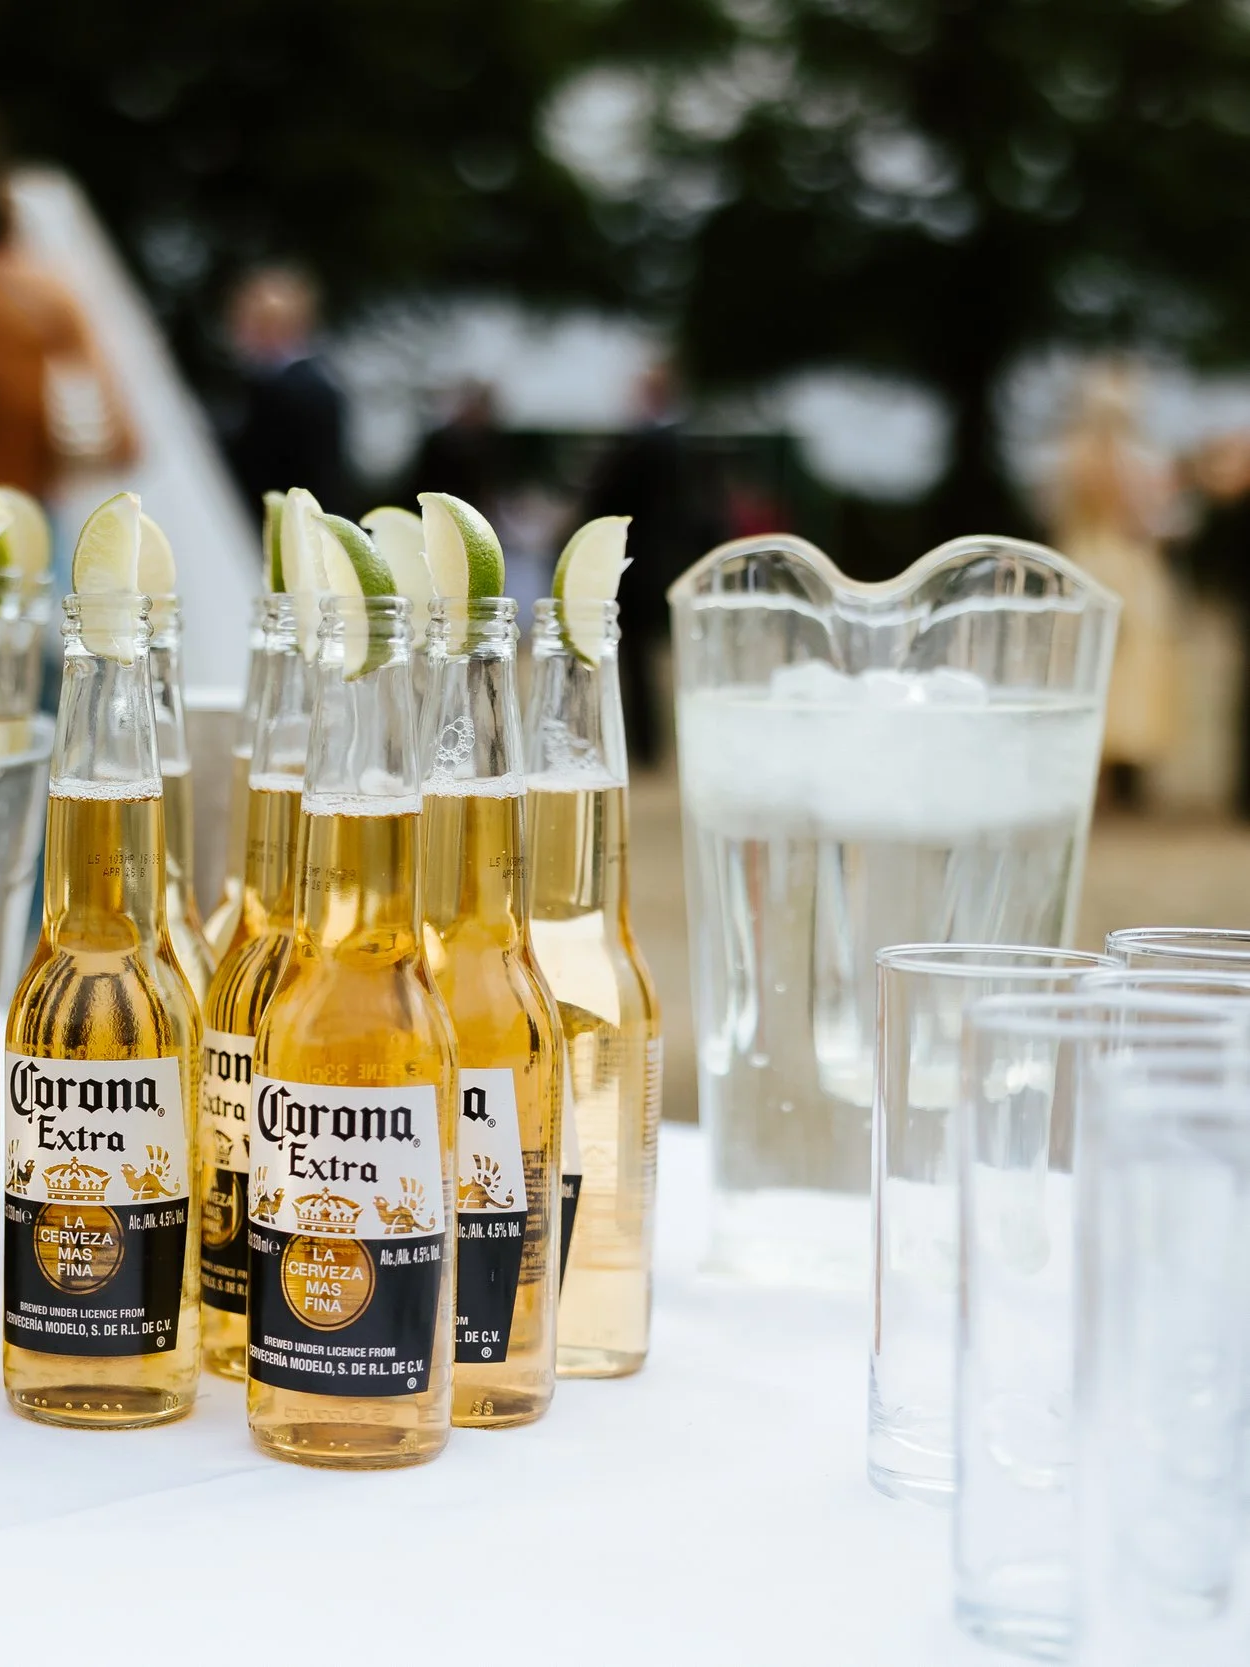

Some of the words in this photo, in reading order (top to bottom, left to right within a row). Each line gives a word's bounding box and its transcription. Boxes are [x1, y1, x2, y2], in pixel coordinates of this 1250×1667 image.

[10, 1060, 160, 1124] Corona
[258, 1084, 415, 1151] Corona
[36, 1114, 125, 1152] Extra
[288, 1141, 379, 1183] Extra
[64, 1216, 86, 1229] LA
[129, 1213, 158, 1230] Alc./Alk.
[159, 1211, 175, 1227] 4.5%
[175, 1208, 185, 1224] Vol.
[40, 1229, 113, 1245] CERVEZA
[487, 1223, 507, 1238] 4.5%
[508, 1221, 521, 1237] Vol.
[58, 1247, 93, 1261] MAS
[313, 1247, 335, 1262] LA
[380, 1248, 411, 1267] Alc./Alk.
[413, 1246, 430, 1263] 4.5%
[430, 1243, 441, 1261] Vol.
[57, 1263, 93, 1277] FINA
[288, 1261, 364, 1280] CERVEZA
[306, 1280, 342, 1296] MAS
[20, 1301, 48, 1315] BREWED
[49, 1307, 78, 1318] UNDER
[80, 1309, 117, 1319] LICENCE
[120, 1308, 145, 1318] FROM
[304, 1296, 342, 1313] FINA
[6, 1310, 43, 1332] CERVECERÍA
[45, 1321, 89, 1338] MODELO,
[91, 1324, 101, 1336] S.
[104, 1324, 118, 1336] DE
[121, 1323, 140, 1335] R.L.
[142, 1321, 154, 1334] DE
[156, 1319, 172, 1332] C.V.
[264, 1335, 293, 1351] BREWED
[295, 1342, 324, 1355] UNDER
[326, 1346, 366, 1357] LICENCE
[369, 1347, 396, 1357] FROM
[465, 1331, 479, 1343] DE
[481, 1331, 500, 1343] C.V.
[249, 1343, 288, 1368] CERVECERÍA
[290, 1357, 335, 1376] MODELO,
[338, 1361, 348, 1375] S.
[351, 1363, 366, 1375] DE
[369, 1362, 389, 1375] R.L.
[392, 1361, 405, 1375] DE
[407, 1359, 424, 1373] C.V.
